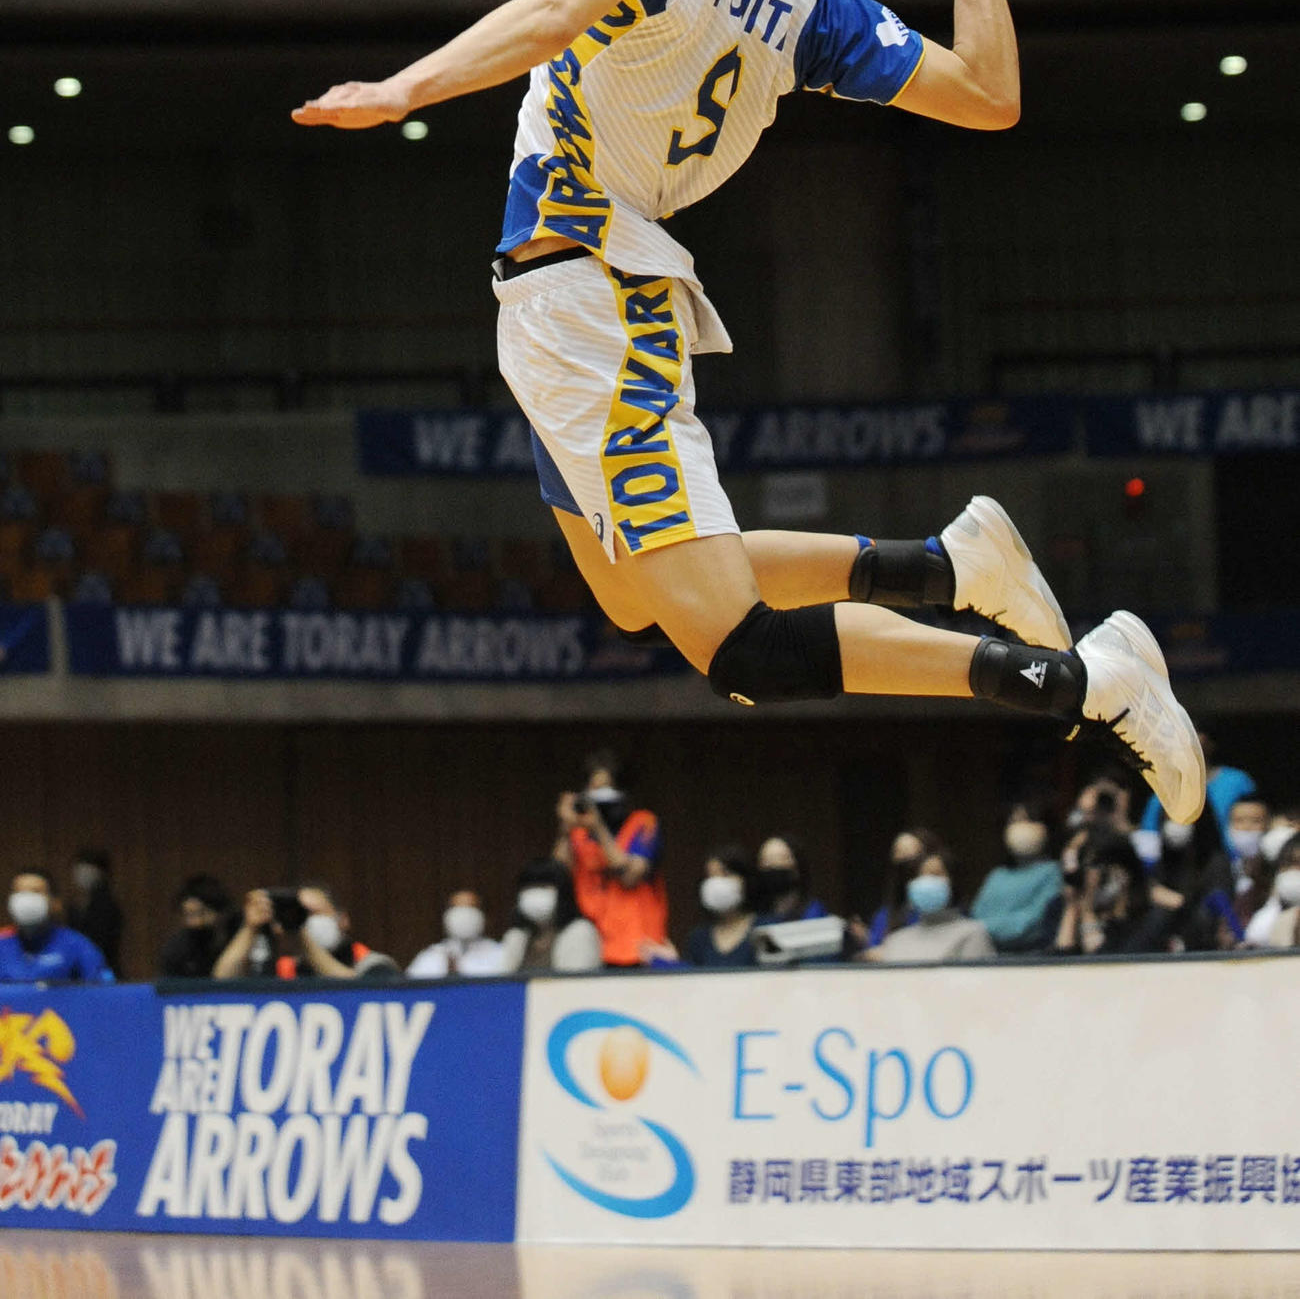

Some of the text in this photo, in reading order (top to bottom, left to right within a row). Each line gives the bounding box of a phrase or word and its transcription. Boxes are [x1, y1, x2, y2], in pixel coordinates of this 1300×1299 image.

[413, 416, 482, 468] WE
[752, 408, 948, 460] ARROWS
[1136, 398, 1202, 447] WE
[604, 357, 691, 552] TORAY
[114, 609, 589, 671] WE ARE TORAY ARROWS
[163, 1004, 217, 1059] WE
[213, 1001, 436, 1116] TORAY
[150, 1057, 220, 1114] ARE
[731, 1027, 977, 1147] E-Spo
[135, 1112, 430, 1224] ARROWS
